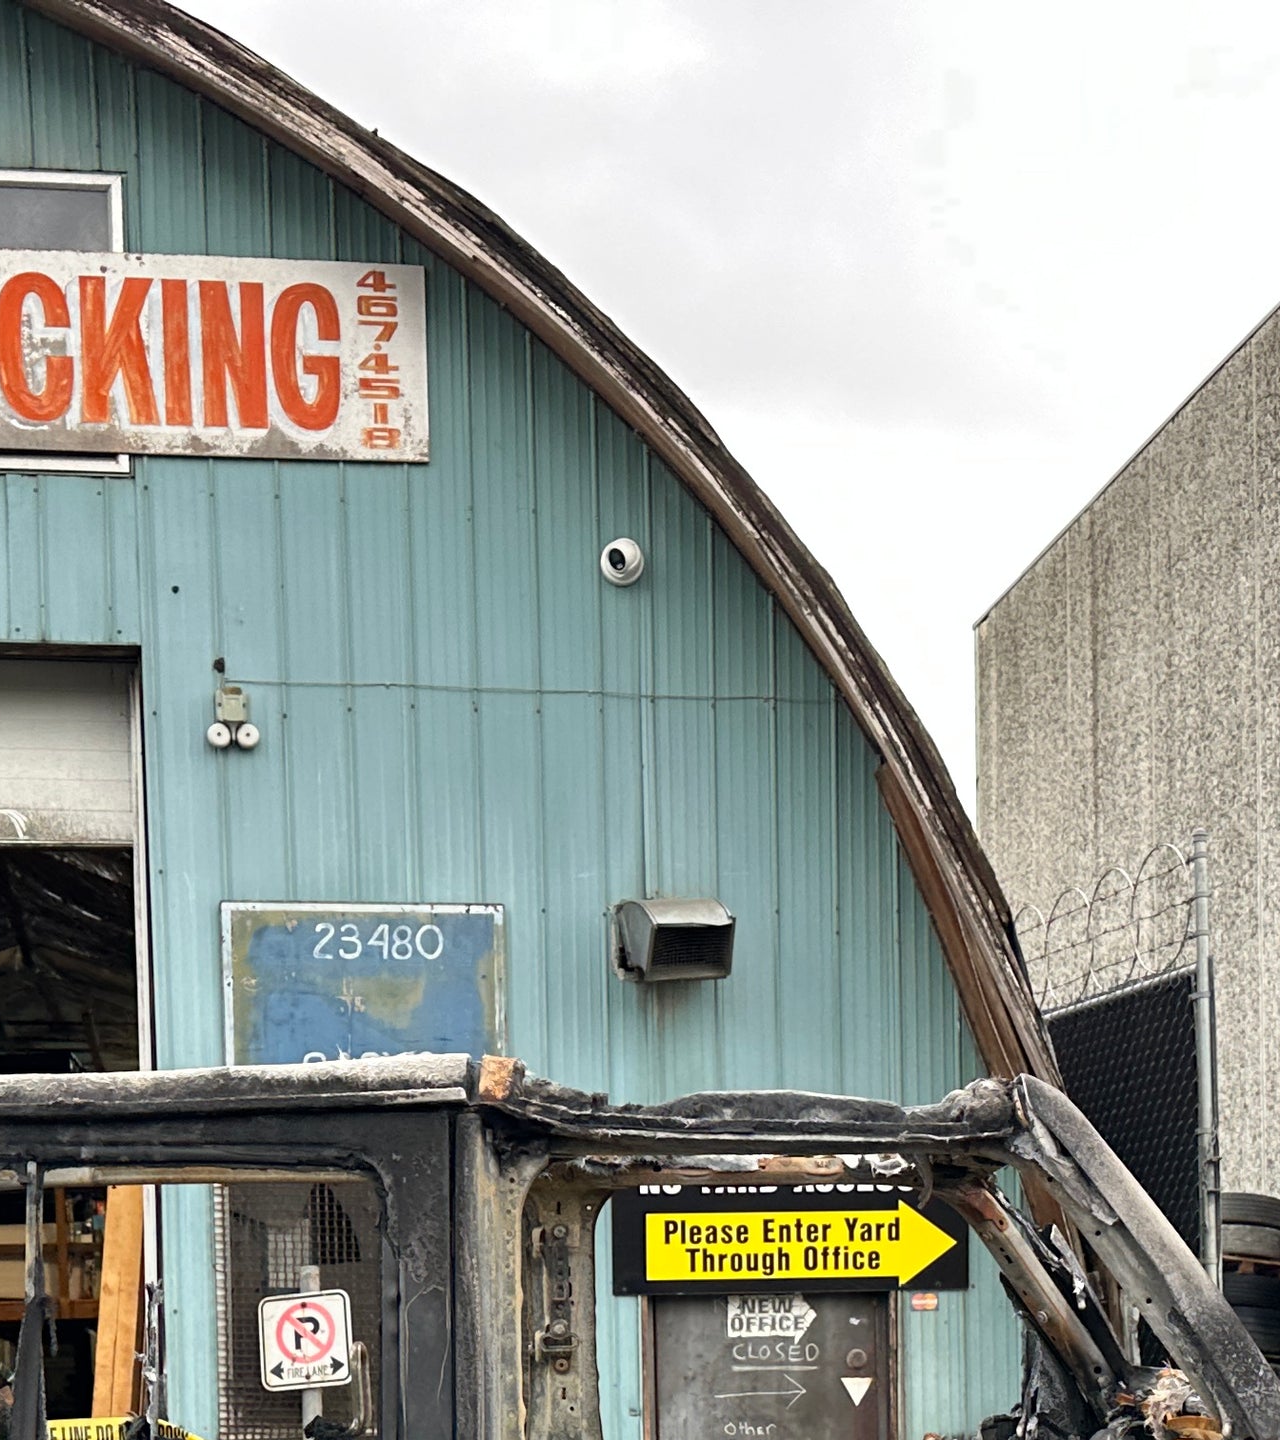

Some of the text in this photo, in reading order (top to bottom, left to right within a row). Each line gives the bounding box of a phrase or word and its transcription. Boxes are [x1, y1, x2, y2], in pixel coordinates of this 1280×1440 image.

[312, 921, 445, 961] 23480
[663, 1217, 901, 1245] Please Enter Yard
[685, 1246, 881, 1276] Through Office
[739, 1298, 794, 1314] NEW
[730, 1314, 806, 1332] OFFICE
[732, 1342, 820, 1362] CLOSED
[287, 1364, 330, 1379] FIRE LANE
[724, 1422, 777, 1437] Other
